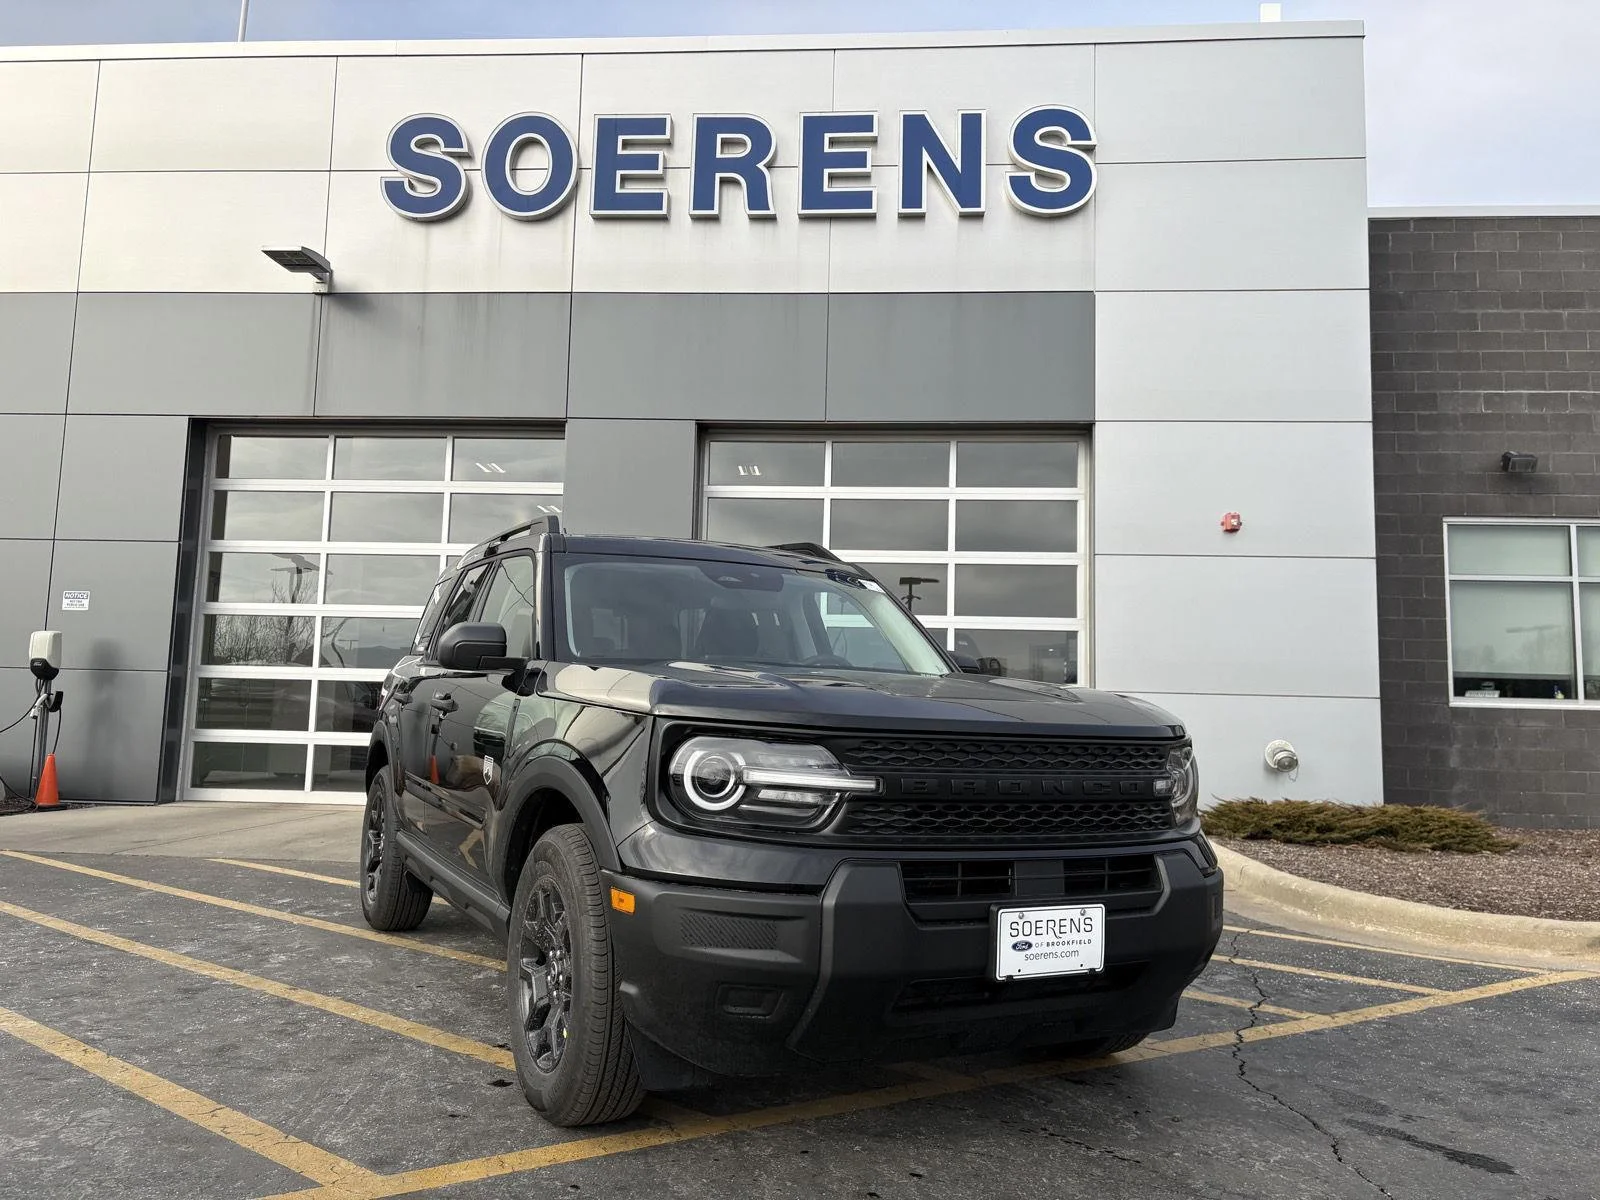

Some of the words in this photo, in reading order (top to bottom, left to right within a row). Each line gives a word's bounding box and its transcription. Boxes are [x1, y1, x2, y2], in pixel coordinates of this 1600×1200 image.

[380, 104, 1097, 221] SOERENS
[901, 778, 1145, 795] BRONCO
[1009, 917, 1093, 939] SOERENS
[1015, 941, 1030, 950] Ford
[1046, 939, 1092, 947] BROOKFIELD
[1024, 949, 1080, 961] soerens.com
